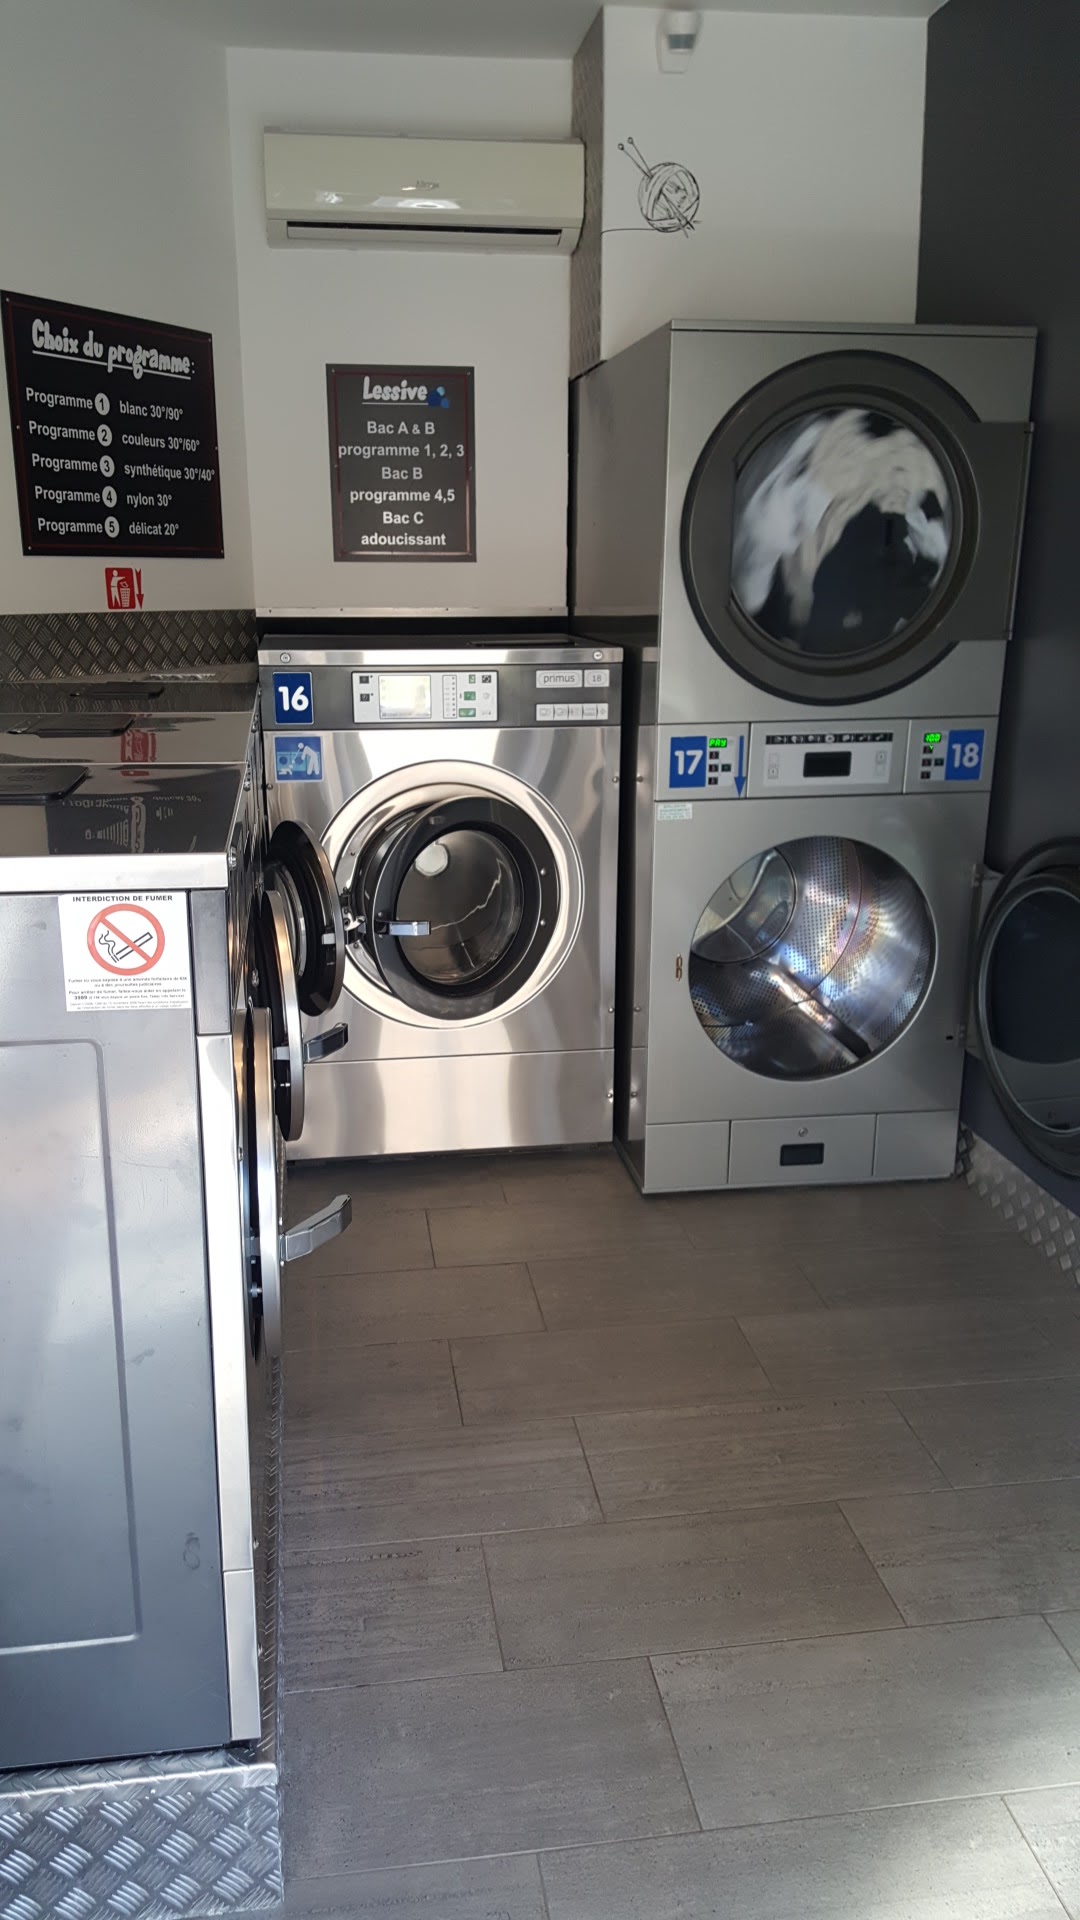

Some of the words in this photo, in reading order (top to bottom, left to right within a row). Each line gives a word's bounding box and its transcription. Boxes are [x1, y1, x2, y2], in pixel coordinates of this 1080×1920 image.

[32, 318, 79, 354] Choix
[82, 329, 104, 358] du
[362, 375, 428, 401] Lessive
[26, 387, 93, 409] Programme
[119, 400, 148, 417] blanc
[150, 404, 183, 421] 30°/90°
[28, 420, 96, 441] Programme
[122, 433, 166, 449] couleurs
[168, 436, 200, 452] 30°/60°
[367, 421, 394, 435] Bac
[398, 421, 409, 435] A
[412, 424, 421, 435] &
[424, 421, 435, 435] B
[338, 445, 420, 459] programme
[424, 444, 436, 459] 1,
[440, 444, 452, 459] 2,
[456, 444, 464, 457] 3
[31, 453, 98, 472] Programme
[124, 463, 182, 481] synthétique
[183, 467, 215, 482] 30°/40°
[381, 467, 408, 480] Bac
[412, 467, 423, 480] B
[34, 485, 101, 504] Programme
[126, 492, 155, 509] nylon
[157, 493, 173, 507] 30°
[350, 490, 430, 504] programme
[434, 489, 455, 503] 4,5
[37, 517, 103, 536] Programme
[129, 521, 163, 536] délicat
[164, 523, 179, 536] 20°
[383, 511, 410, 524] Bac
[413, 511, 424, 524] C
[361, 532, 446, 546] adoucissant
[543, 674, 575, 685] primus
[592, 674, 602, 683] 18
[278, 685, 309, 712] 16
[709, 738, 727, 748] PAY
[674, 749, 703, 776] 17
[951, 742, 979, 769] 18
